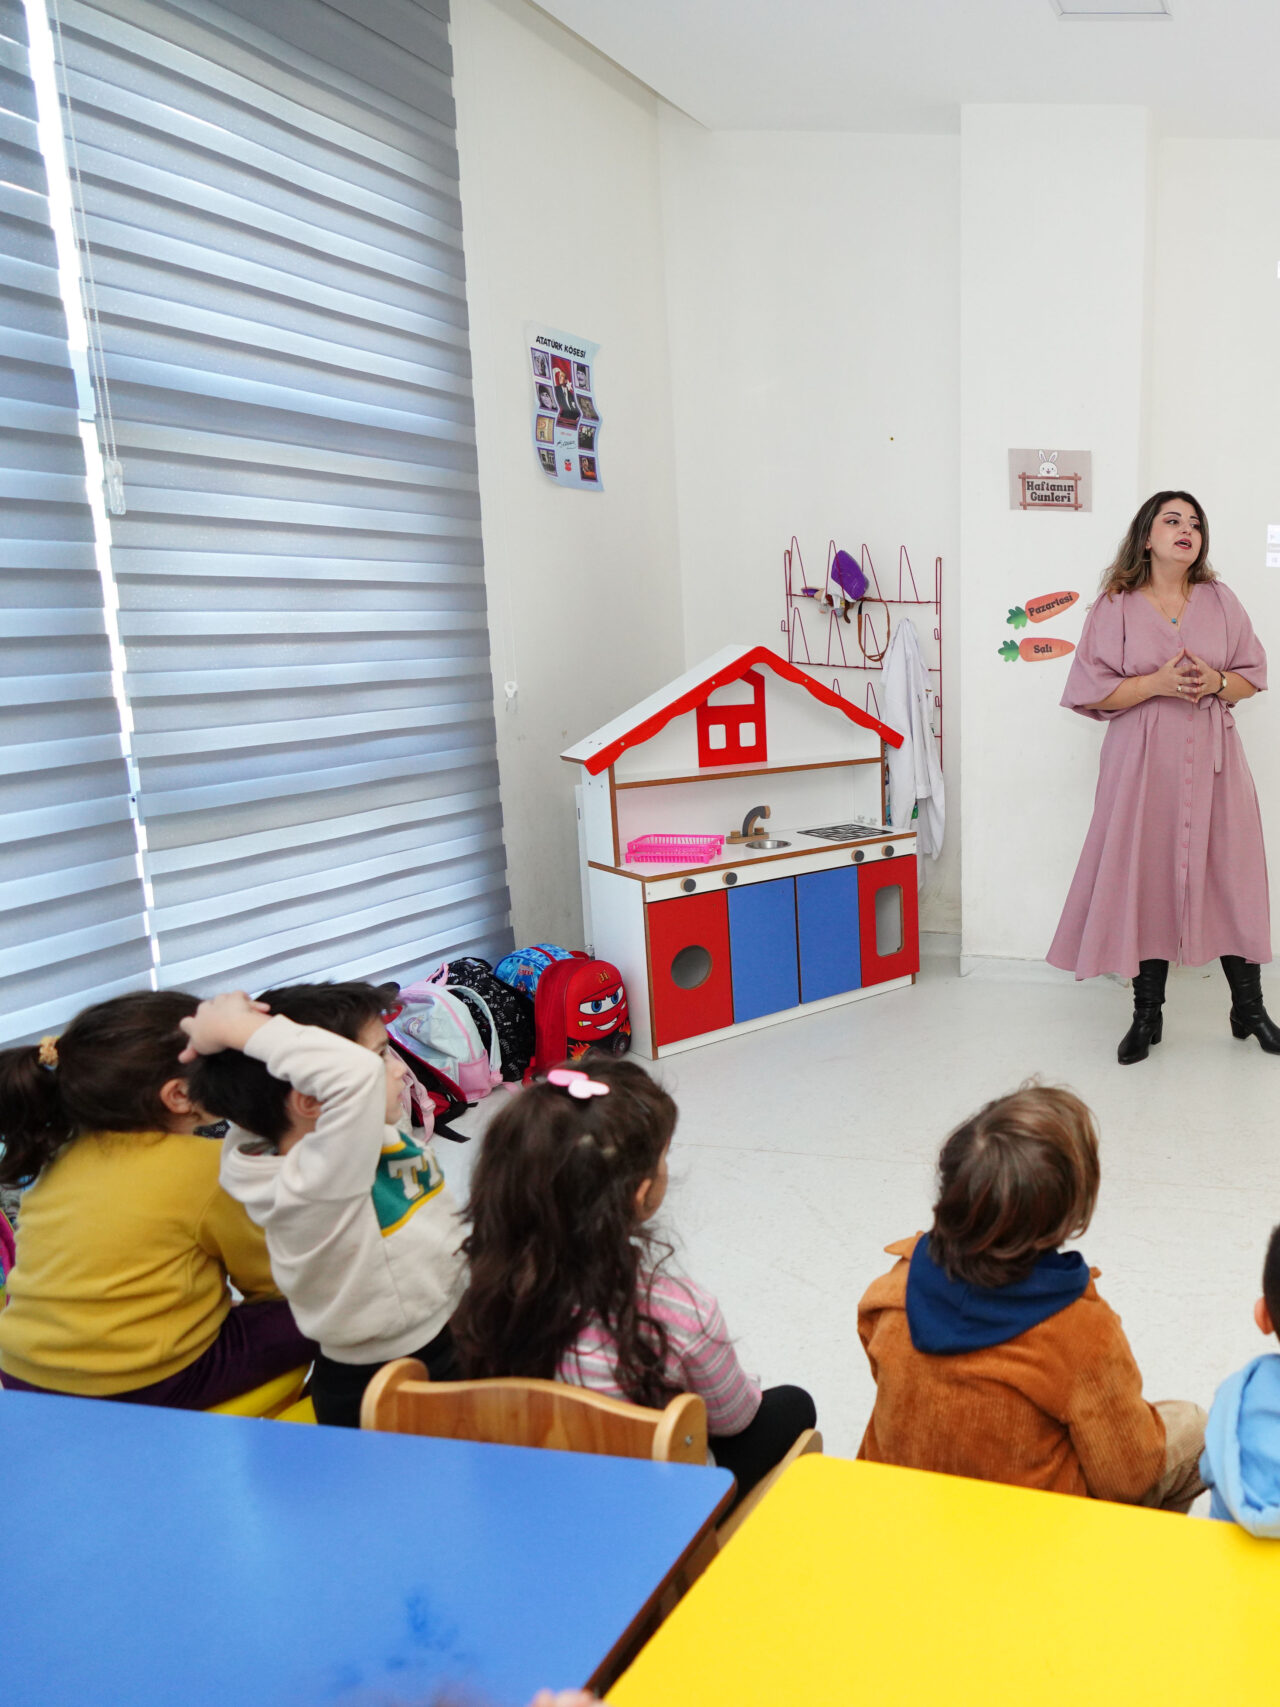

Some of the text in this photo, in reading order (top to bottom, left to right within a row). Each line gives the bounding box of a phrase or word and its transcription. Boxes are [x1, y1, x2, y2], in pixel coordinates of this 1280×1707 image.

[535, 335, 587, 358] ATATÜRK KÖŞESİ
[1026, 480, 1075, 492] Haftanın
[1030, 491, 1071, 502] Günleri
[1028, 592, 1073, 617] Pazartesi
[1033, 644, 1053, 654] Salı
